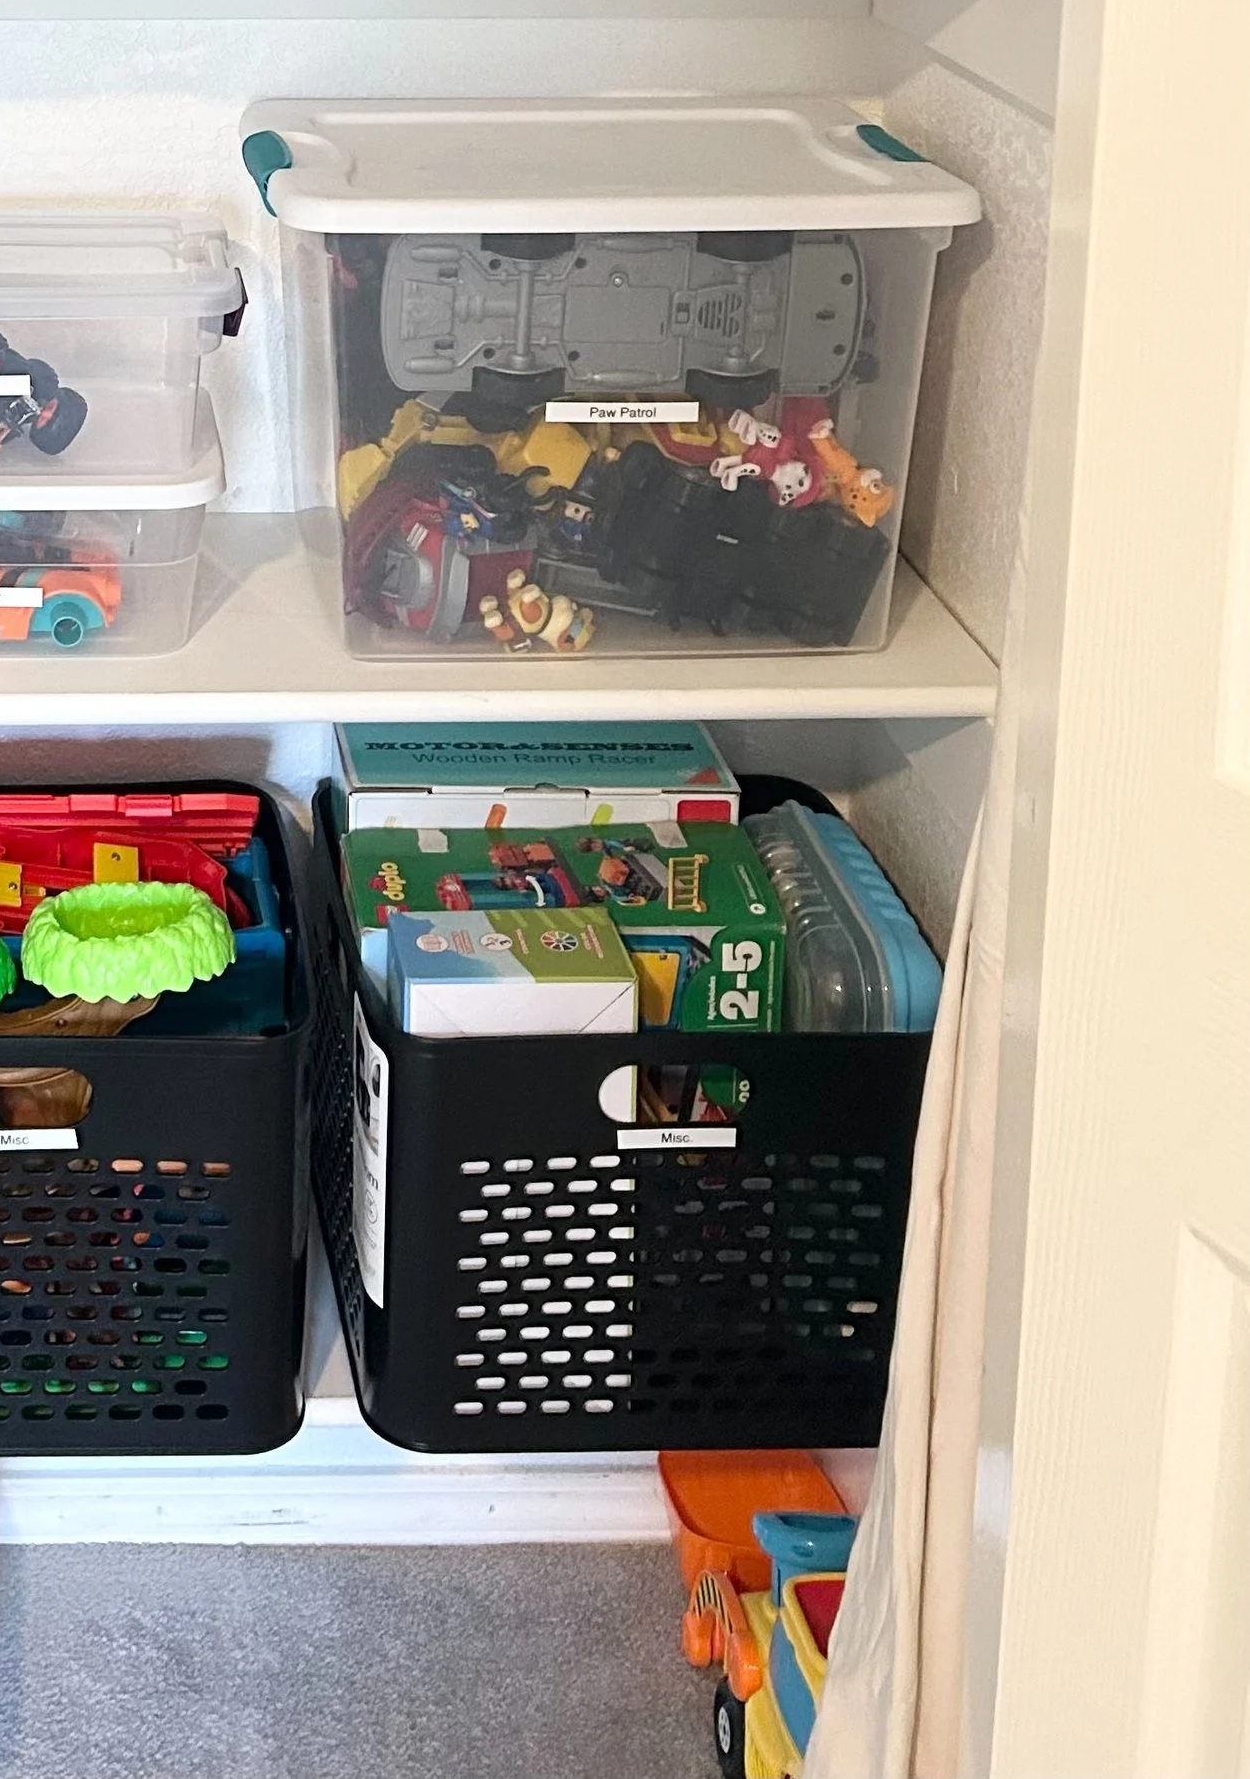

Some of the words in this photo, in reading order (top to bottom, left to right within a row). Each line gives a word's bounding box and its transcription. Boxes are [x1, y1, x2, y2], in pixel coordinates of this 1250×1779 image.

[589, 406, 616, 418] Paw
[620, 406, 657, 418] Patrol
[411, 753, 506, 765] Wooden
[513, 753, 582, 766] Ramp
[588, 753, 655, 765] Racer
[378, 862, 406, 901] duplo
[720, 940, 762, 1020] 2-5
